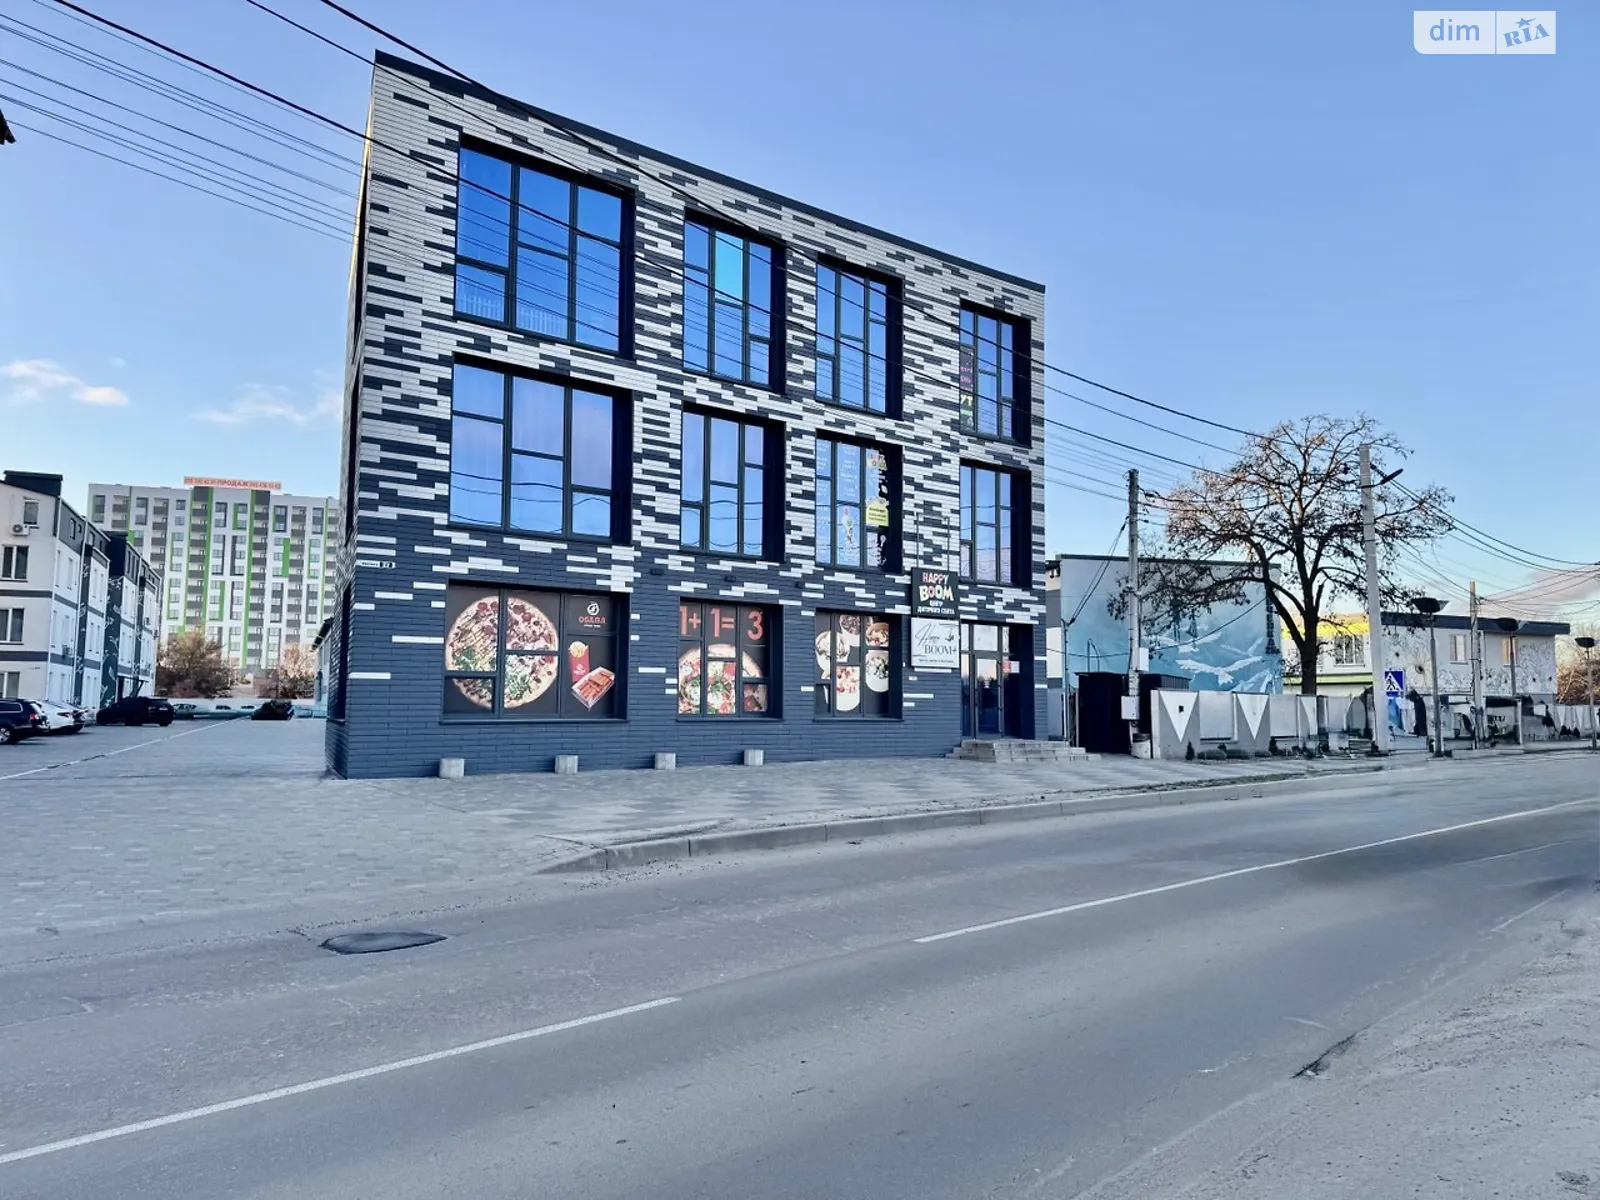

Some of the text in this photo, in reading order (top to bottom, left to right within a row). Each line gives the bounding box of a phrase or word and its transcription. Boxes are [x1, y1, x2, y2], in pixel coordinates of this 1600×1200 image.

[922, 572, 949, 584] HAPPY
[919, 585, 954, 602] BOOM
[748, 610, 763, 640] 3
